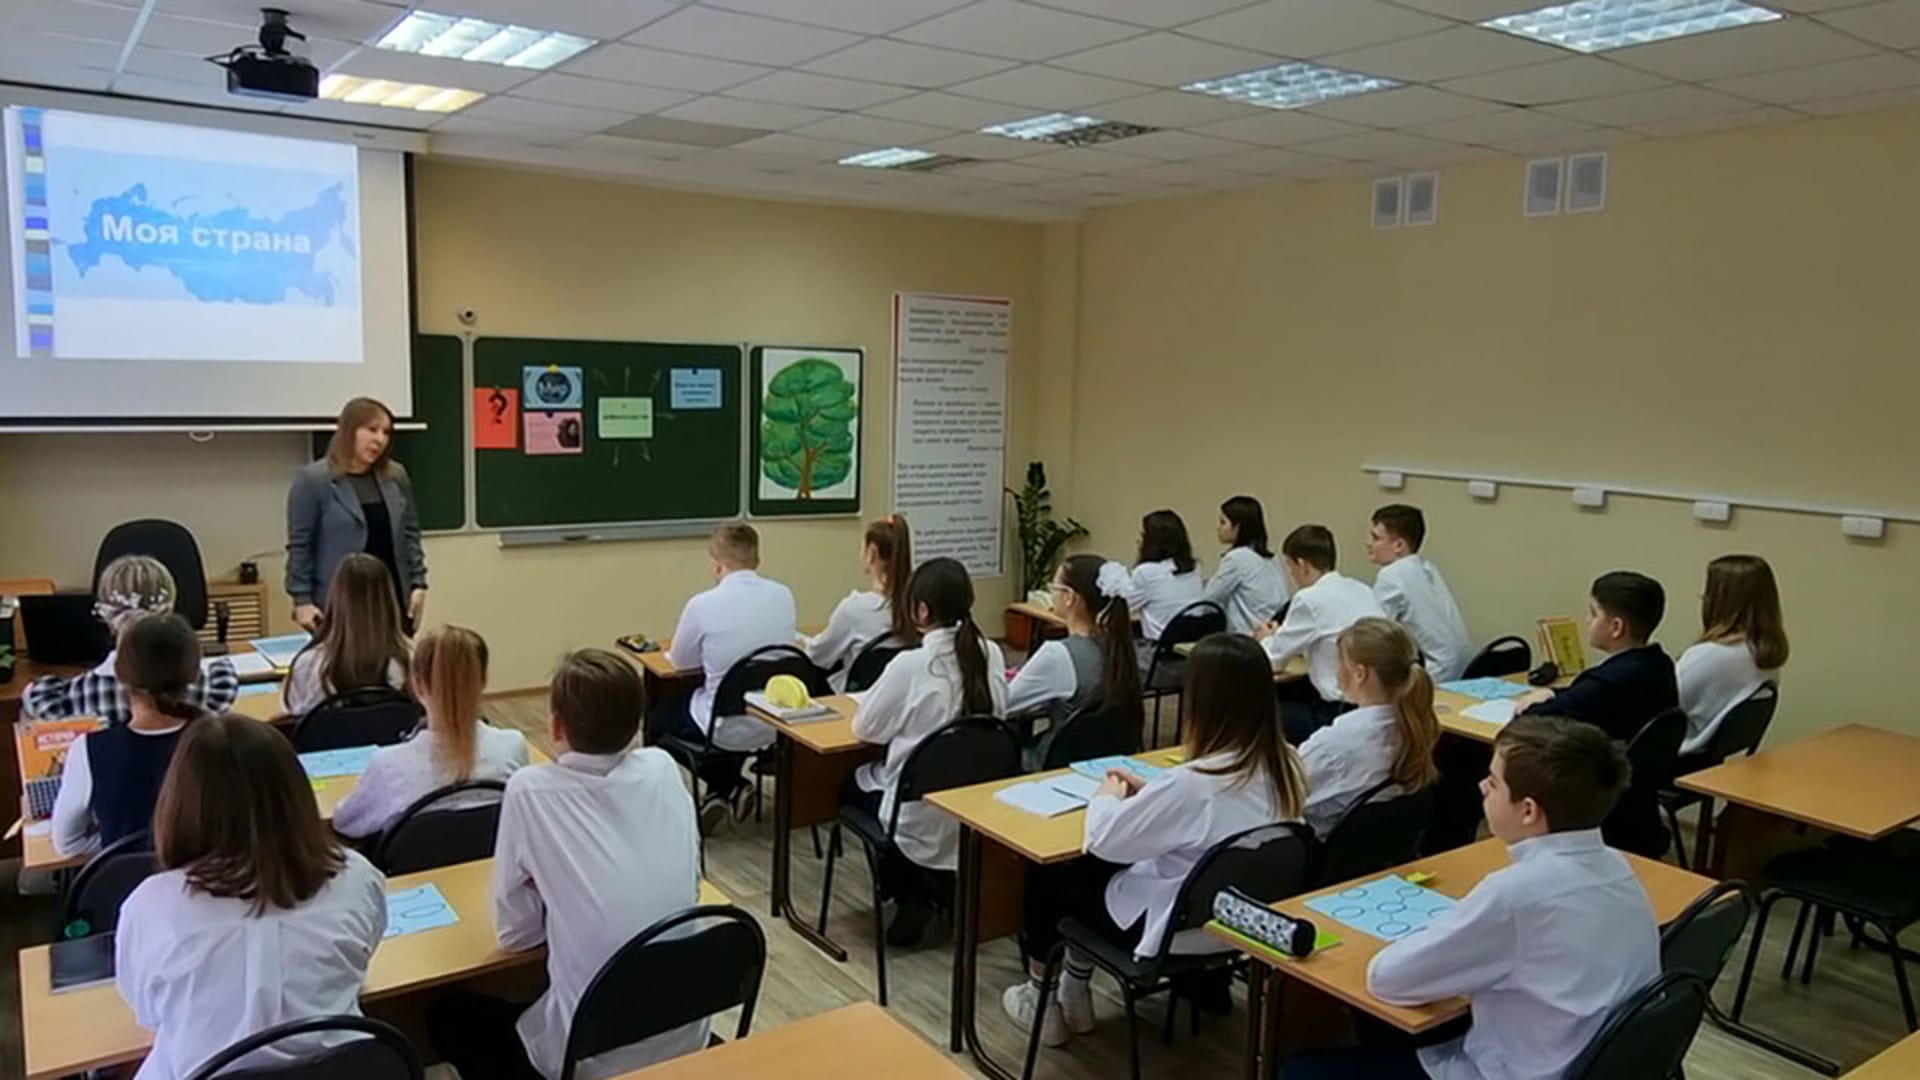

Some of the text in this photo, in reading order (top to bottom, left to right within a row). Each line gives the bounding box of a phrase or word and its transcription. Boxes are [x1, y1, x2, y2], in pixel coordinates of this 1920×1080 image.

[101, 213, 311, 255] Моя страна
[487, 390, 508, 425] ?
